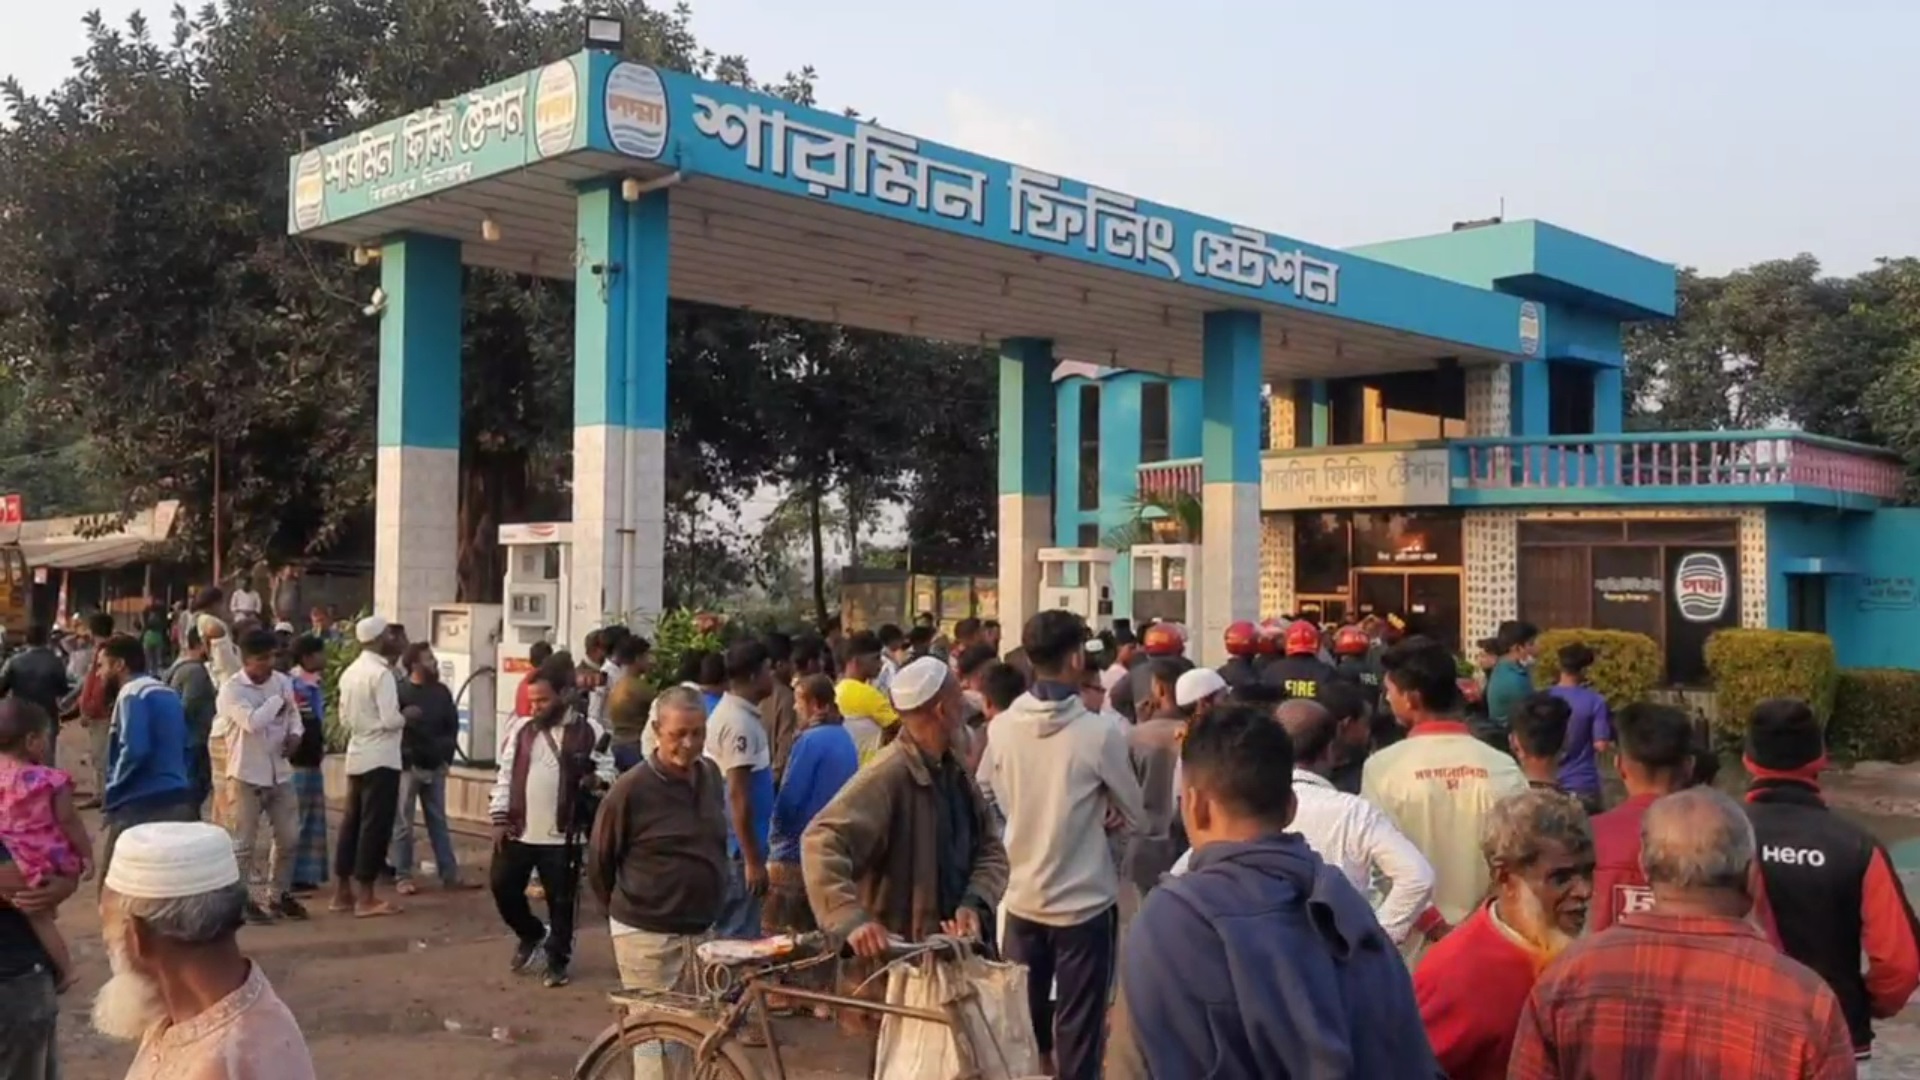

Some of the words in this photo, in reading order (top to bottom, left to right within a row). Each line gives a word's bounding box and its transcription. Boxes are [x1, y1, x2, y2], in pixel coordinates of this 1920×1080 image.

[325, 130, 396, 193] শারমিন
[402, 110, 454, 172] ফিলিং
[692, 93, 987, 226] শারমিন
[1007, 164, 1181, 281] ফিলিং
[1323, 456, 1379, 490] ফিলিং
[1284, 679, 1317, 697] FIRE
[736, 735, 748, 753] 3
[1761, 844, 1826, 868] Hero
